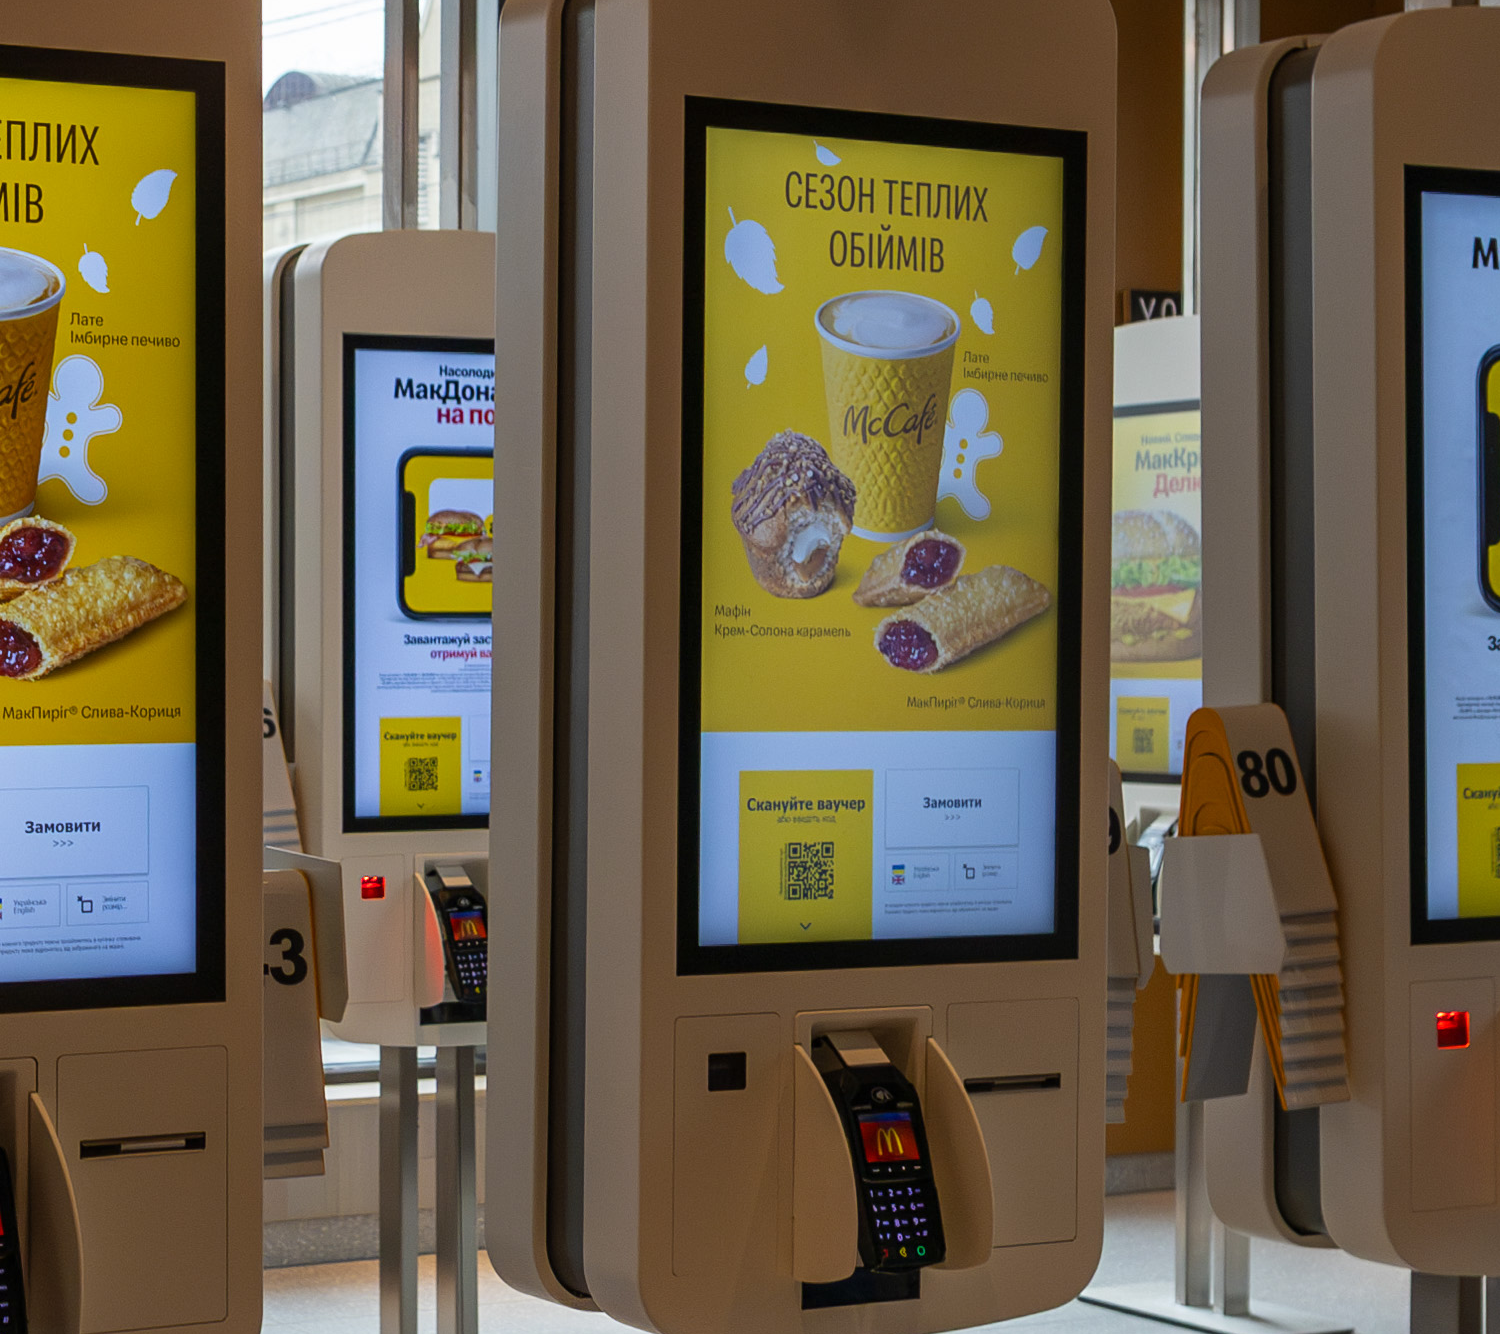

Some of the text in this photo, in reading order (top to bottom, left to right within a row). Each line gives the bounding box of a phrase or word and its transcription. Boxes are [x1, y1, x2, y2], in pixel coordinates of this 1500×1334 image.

[785, 171, 989, 223] СЕЗОН ТЕПЛИХ
[829, 224, 945, 274] ОБІЙМІВ
[69, 312, 104, 328] Лате
[69, 330, 181, 349] Імбирне печиво
[963, 351, 990, 365] Лате
[963, 367, 1049, 383] Імбирне печиво
[437, 407, 464, 424] на
[714, 604, 752, 619] Мафін
[714, 623, 852, 639] Крем-Солона карамель
[404, 633, 471, 647] Завантажуй
[430, 648, 478, 662] отримуй
[967, 696, 1046, 711] Слива-Кориця
[80, 704, 182, 721] Слива-Кориця
[1236, 748, 1297, 798] 80
[746, 795, 866, 815] Скануйте ваучер
[923, 796, 982, 809] Замовити
[24, 819, 101, 835] Замовити
